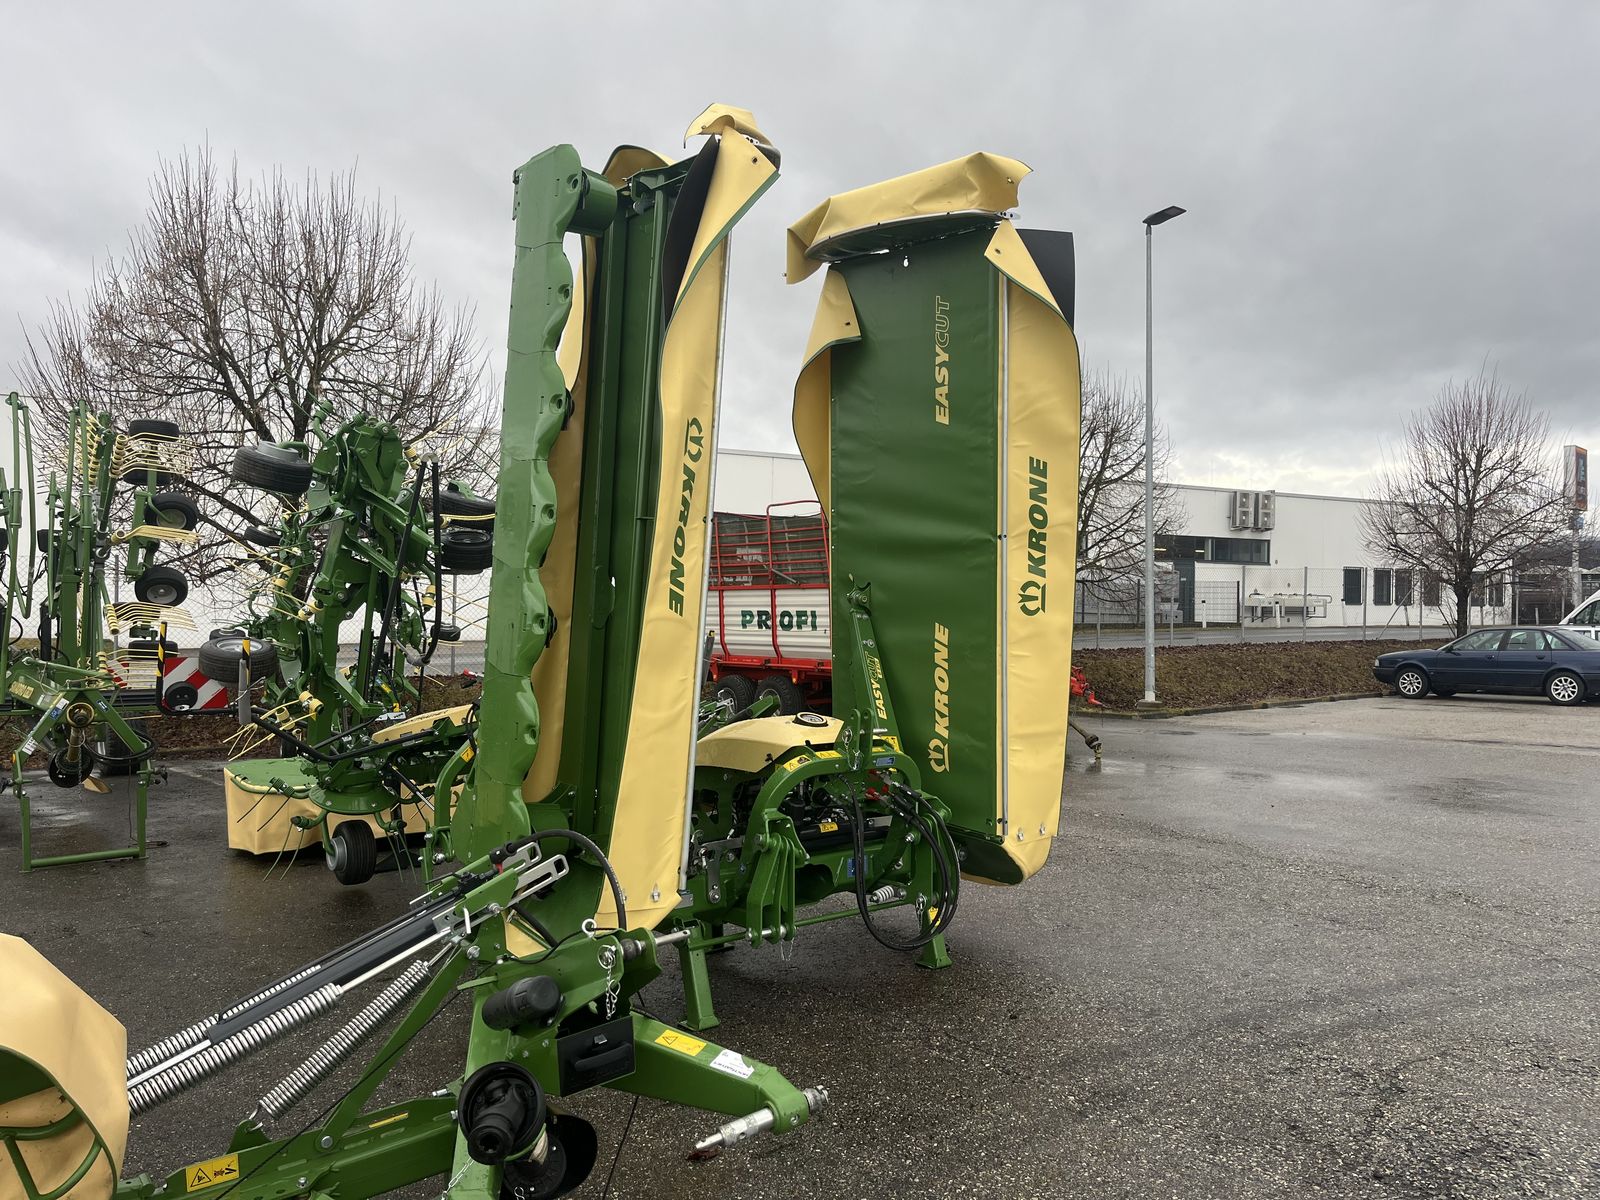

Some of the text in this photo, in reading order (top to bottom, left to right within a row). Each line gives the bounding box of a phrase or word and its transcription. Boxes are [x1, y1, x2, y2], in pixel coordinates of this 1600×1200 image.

[935, 295, 950, 425] EASYCUT
[668, 463, 696, 617] KRONE
[1027, 456, 1048, 579] KRONE
[740, 610, 818, 632] PROFI
[934, 622, 950, 739] KRONE
[864, 651, 888, 720] EASYCUT
